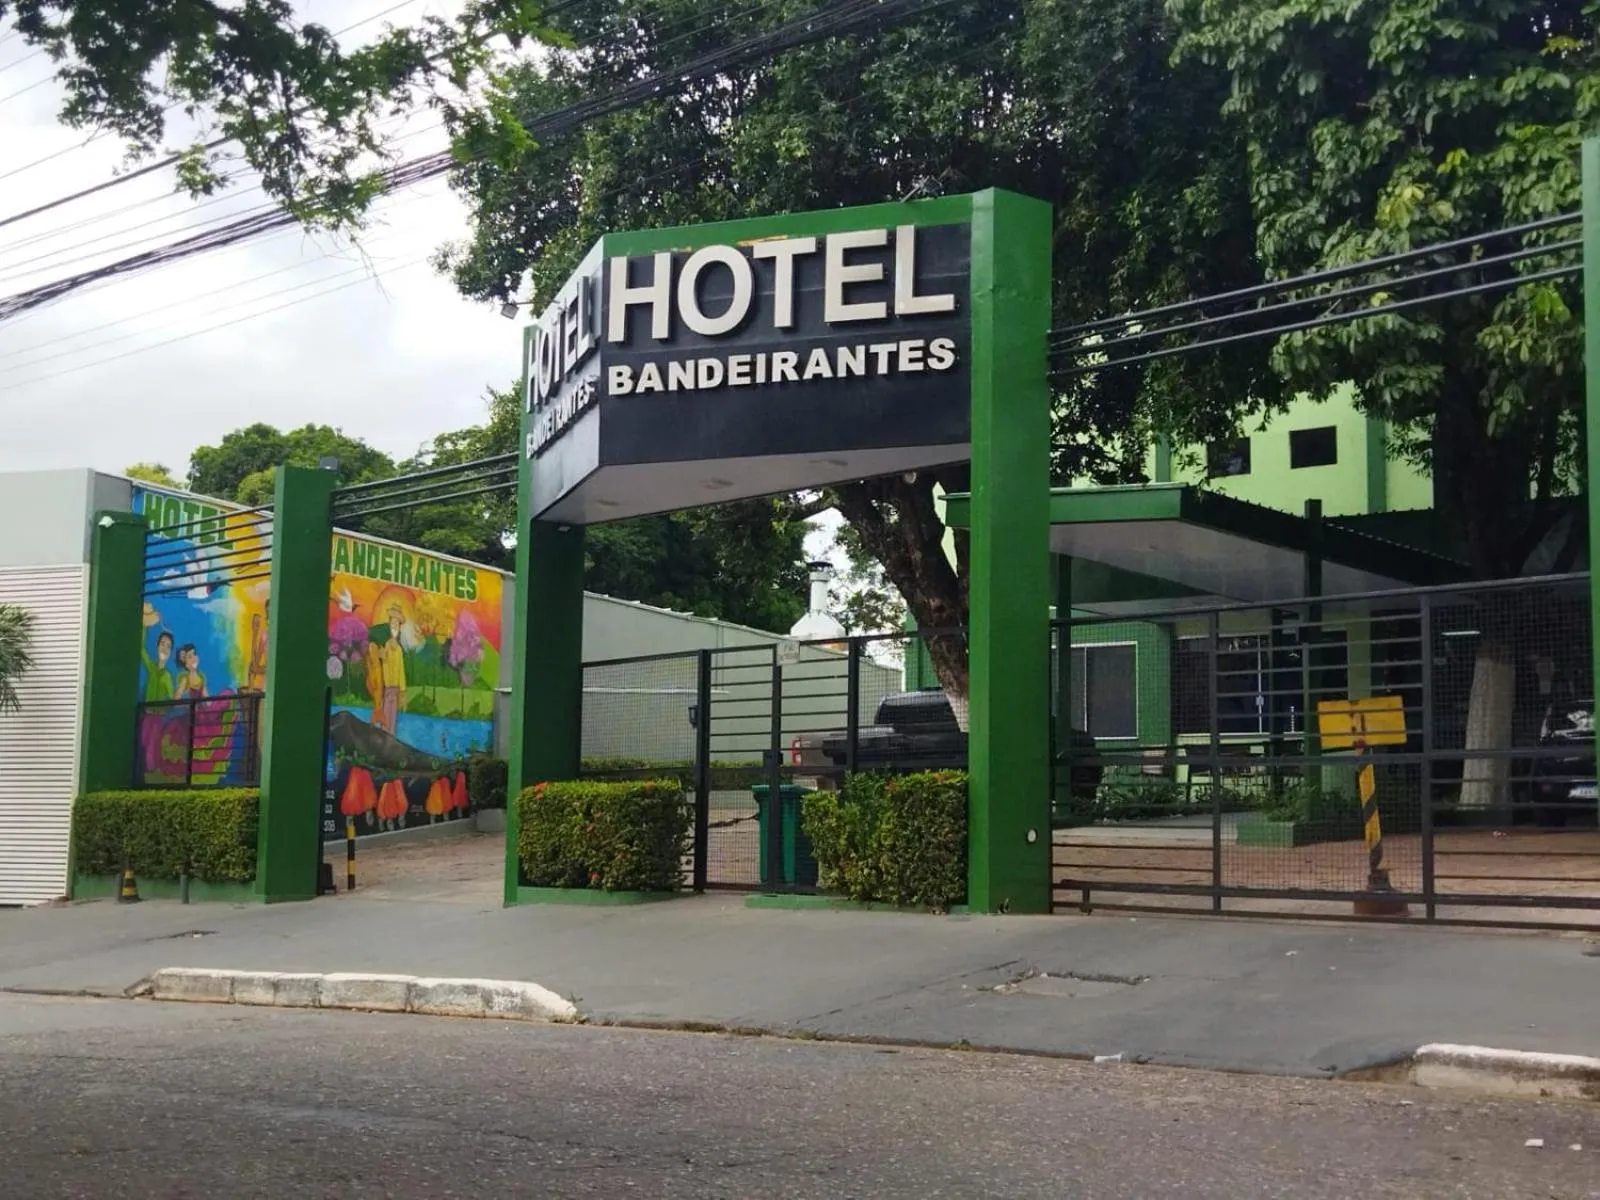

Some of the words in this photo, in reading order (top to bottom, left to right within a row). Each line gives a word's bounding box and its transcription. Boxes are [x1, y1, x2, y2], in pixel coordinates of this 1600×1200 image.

[608, 224, 955, 342] HOTEL
[526, 275, 596, 414] HOTEL
[607, 337, 956, 396] BANDEIRANTES
[143, 491, 235, 551] HOTEL
[332, 537, 477, 601] ANDEIRANTES
